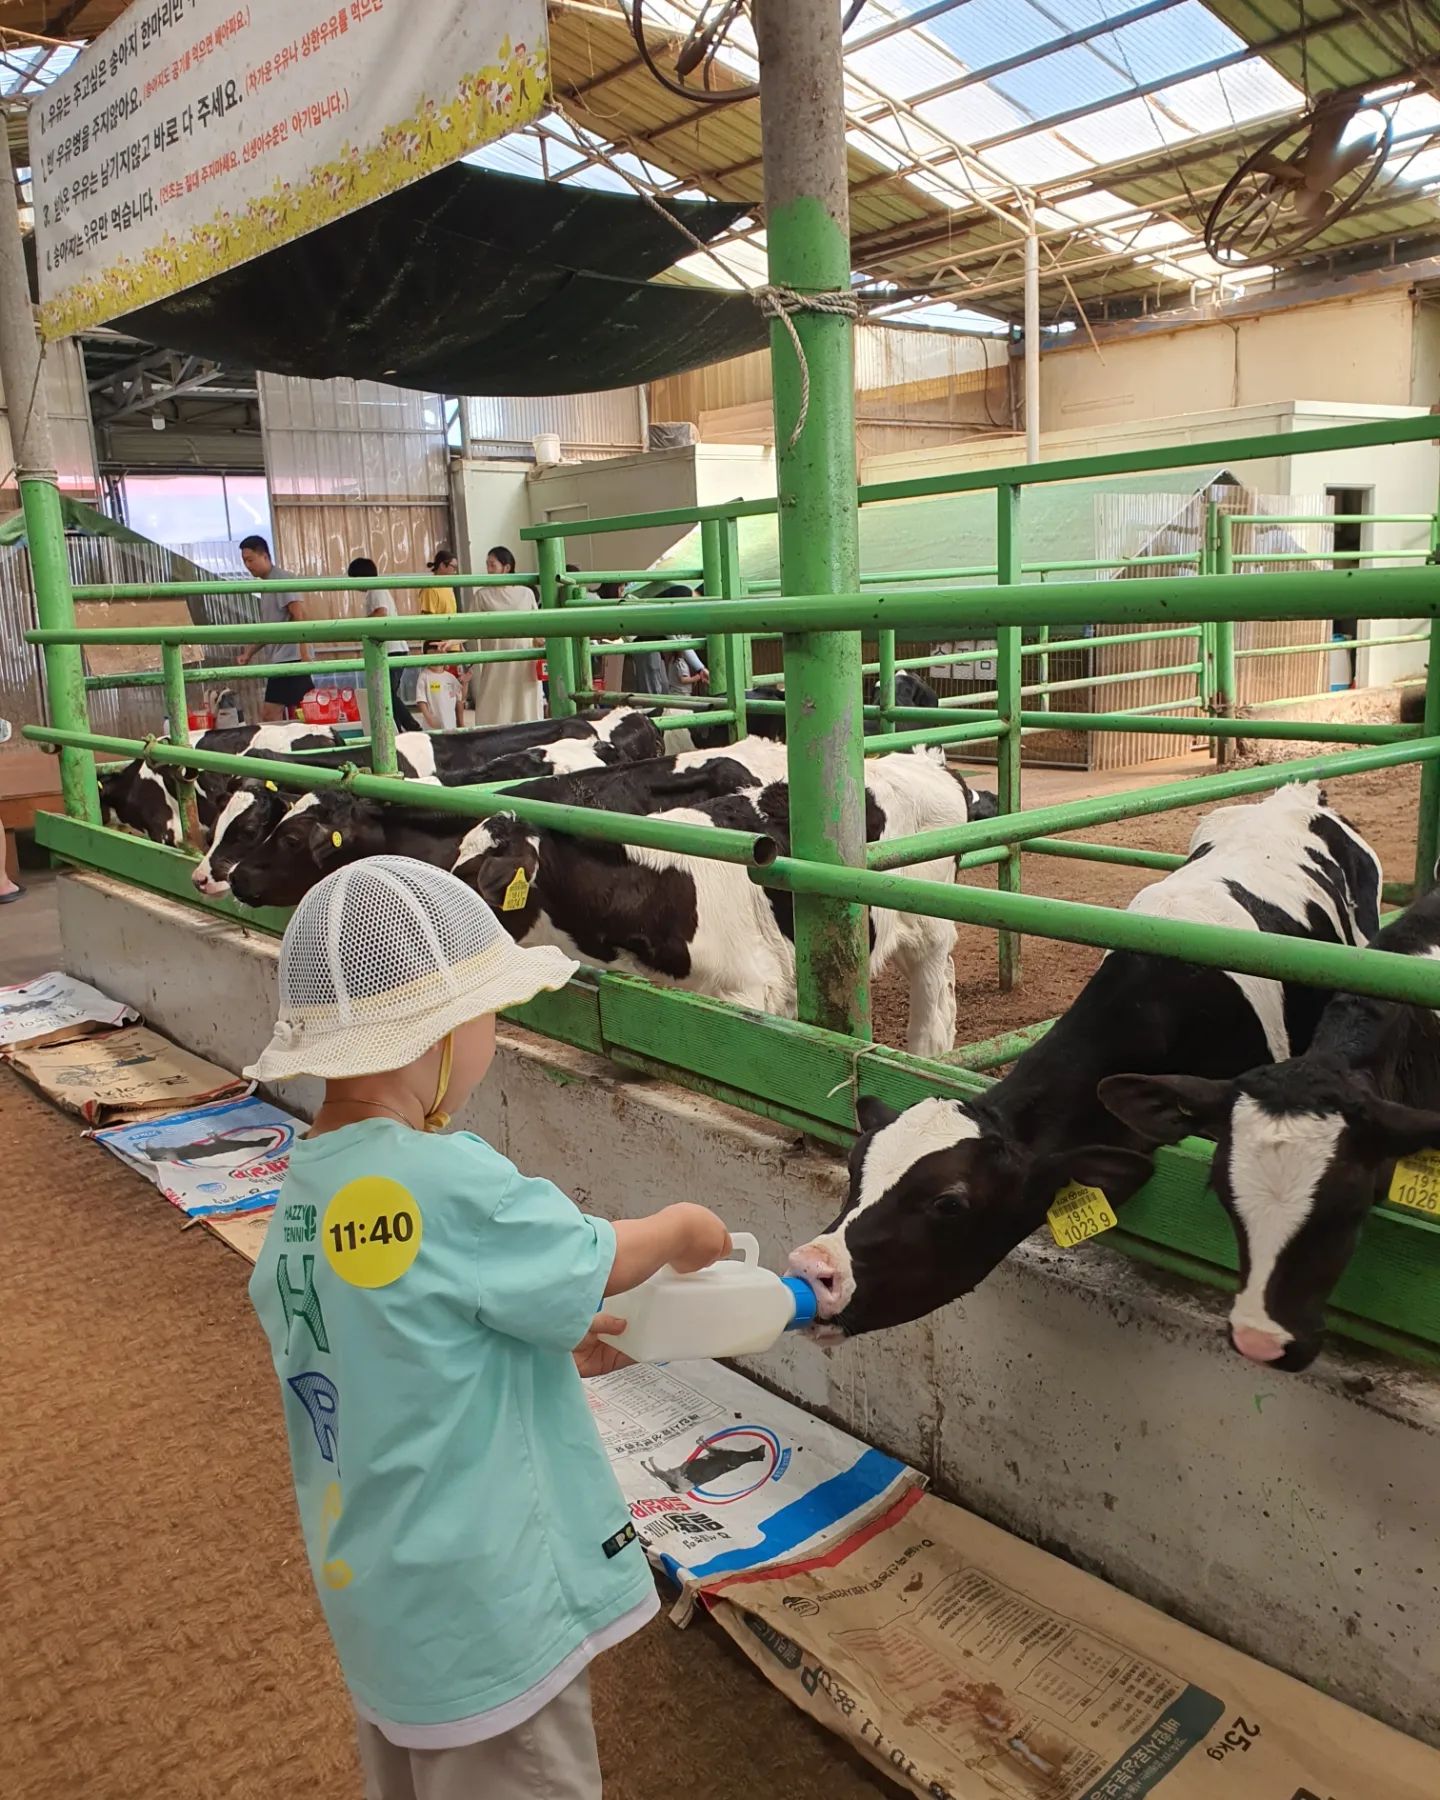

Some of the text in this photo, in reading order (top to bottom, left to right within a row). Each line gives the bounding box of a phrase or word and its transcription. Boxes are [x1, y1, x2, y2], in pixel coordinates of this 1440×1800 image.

[48, 94, 71, 128] 우유는
[73, 60, 107, 107] 주고싶은
[109, 29, 138, 78] 송아지
[140, 0, 183, 50] 한마리만
[56, 125, 89, 168] 우유병을
[91, 87, 142, 142] 주지않아요.
[72, 170, 98, 205] 우유는
[100, 133, 151, 188] 남기지않고
[153, 117, 179, 152] 바로
[182, 104, 193, 136] 다
[198, 79, 243, 128] 주세요.
[274, 40, 299, 75] 우유나
[301, 7, 349, 58] 상한우유를
[53, 233, 84, 269] 송아지는
[84, 212, 108, 249] 우유만
[111, 187, 158, 233] 먹습니다.
[242, 119, 289, 164] 신생아수준인
[291, 88, 350, 135] 아기입니다.)
[329, 1211, 414, 1253] 11:40
[1067, 1205, 1095, 1224] 1911
[1206, 1716, 1262, 1762] 25kg
